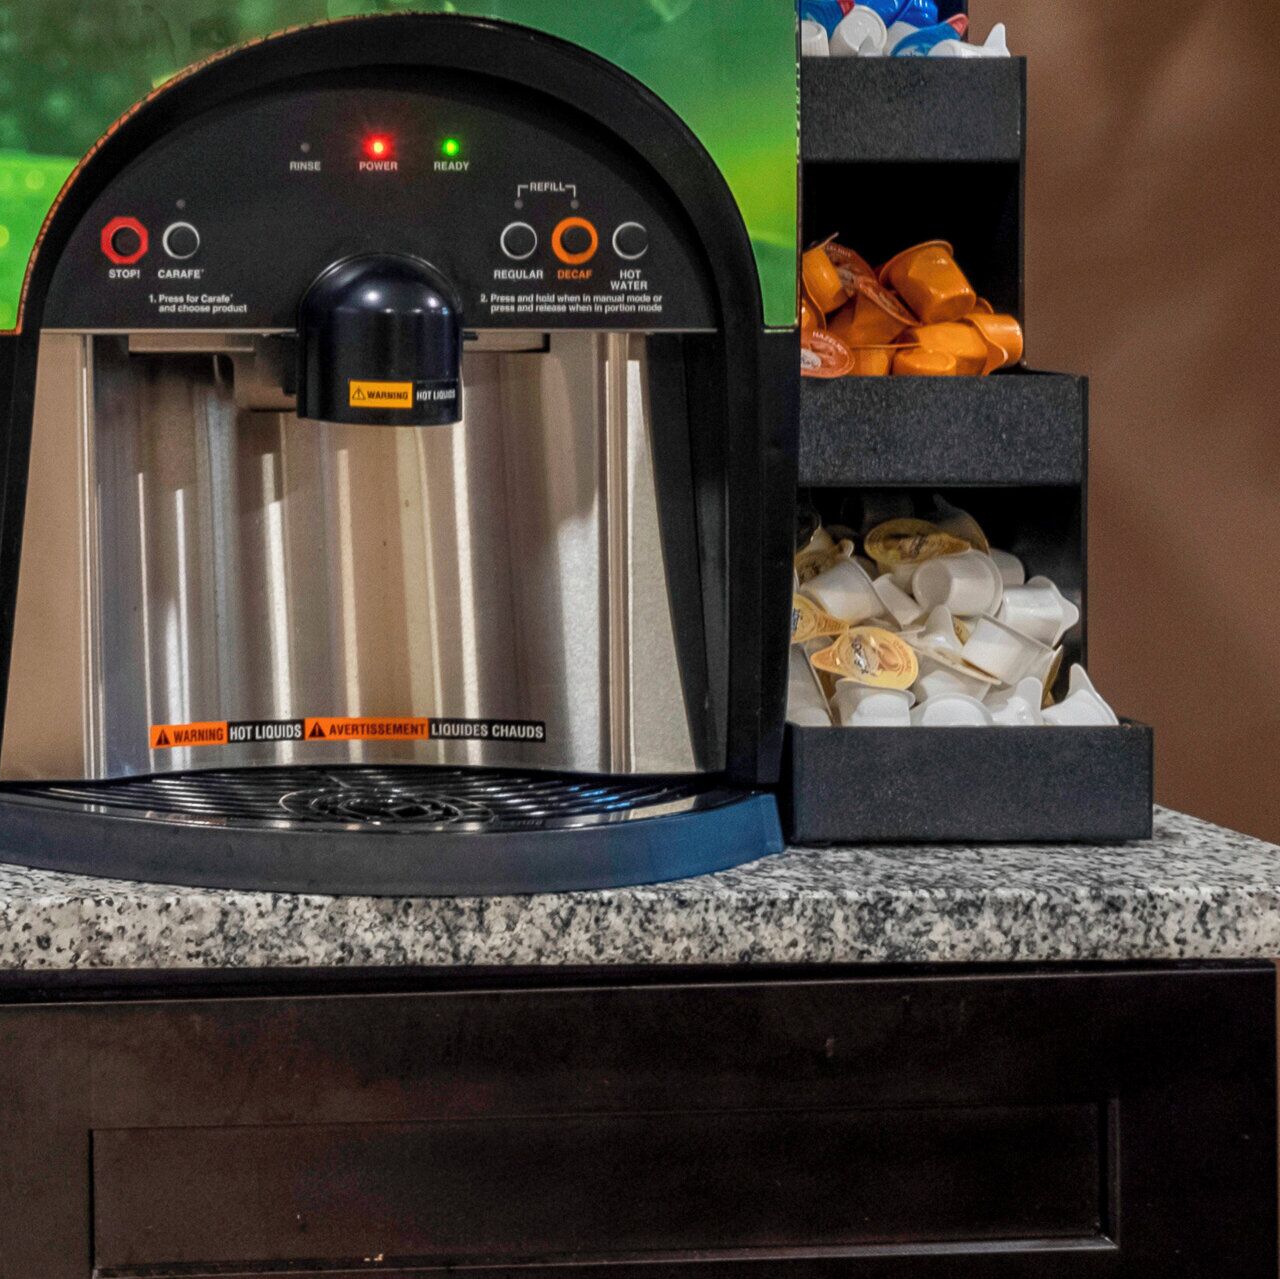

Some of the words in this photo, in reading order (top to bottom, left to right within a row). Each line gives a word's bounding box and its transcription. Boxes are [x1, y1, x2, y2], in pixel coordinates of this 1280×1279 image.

[290, 161, 321, 171] RINSE
[359, 161, 398, 171] POWER
[434, 161, 469, 171] READY
[529, 181, 566, 193] REFILL
[108, 269, 141, 279] STOP!
[493, 269, 544, 281] REGULAR
[557, 269, 593, 280] DECAF
[619, 269, 642, 280] HOT
[610, 280, 648, 291] WATER
[148, 293, 157, 304] 1.
[158, 293, 184, 304] Press
[186, 293, 199, 304] for
[480, 293, 489, 303] 2.
[490, 293, 516, 303] Press
[517, 293, 534, 303] and
[535, 293, 555, 303] hold
[556, 293, 581, 303] when
[582, 293, 591, 303] in
[593, 293, 625, 303] manual
[626, 293, 651, 303] mode
[652, 294, 663, 303] or
[158, 304, 176, 313] and
[177, 304, 211, 313] choose
[211, 304, 247, 315] product
[490, 304, 515, 315] press
[517, 303, 534, 313] and
[535, 303, 567, 313] release
[568, 303, 592, 313] when
[594, 303, 603, 313] in
[604, 303, 636, 315] portion
[637, 303, 663, 313] mode
[366, 390, 409, 401] WARNING
[416, 390, 432, 401] HOT
[173, 727, 224, 744] WARNING
[229, 725, 252, 741] HOT
[254, 723, 302, 740] LIQUIDS
[329, 722, 425, 736] AVERTISSEMENT
[431, 722, 488, 737] LIQUIDES
[491, 724, 544, 738] CHAUDS
